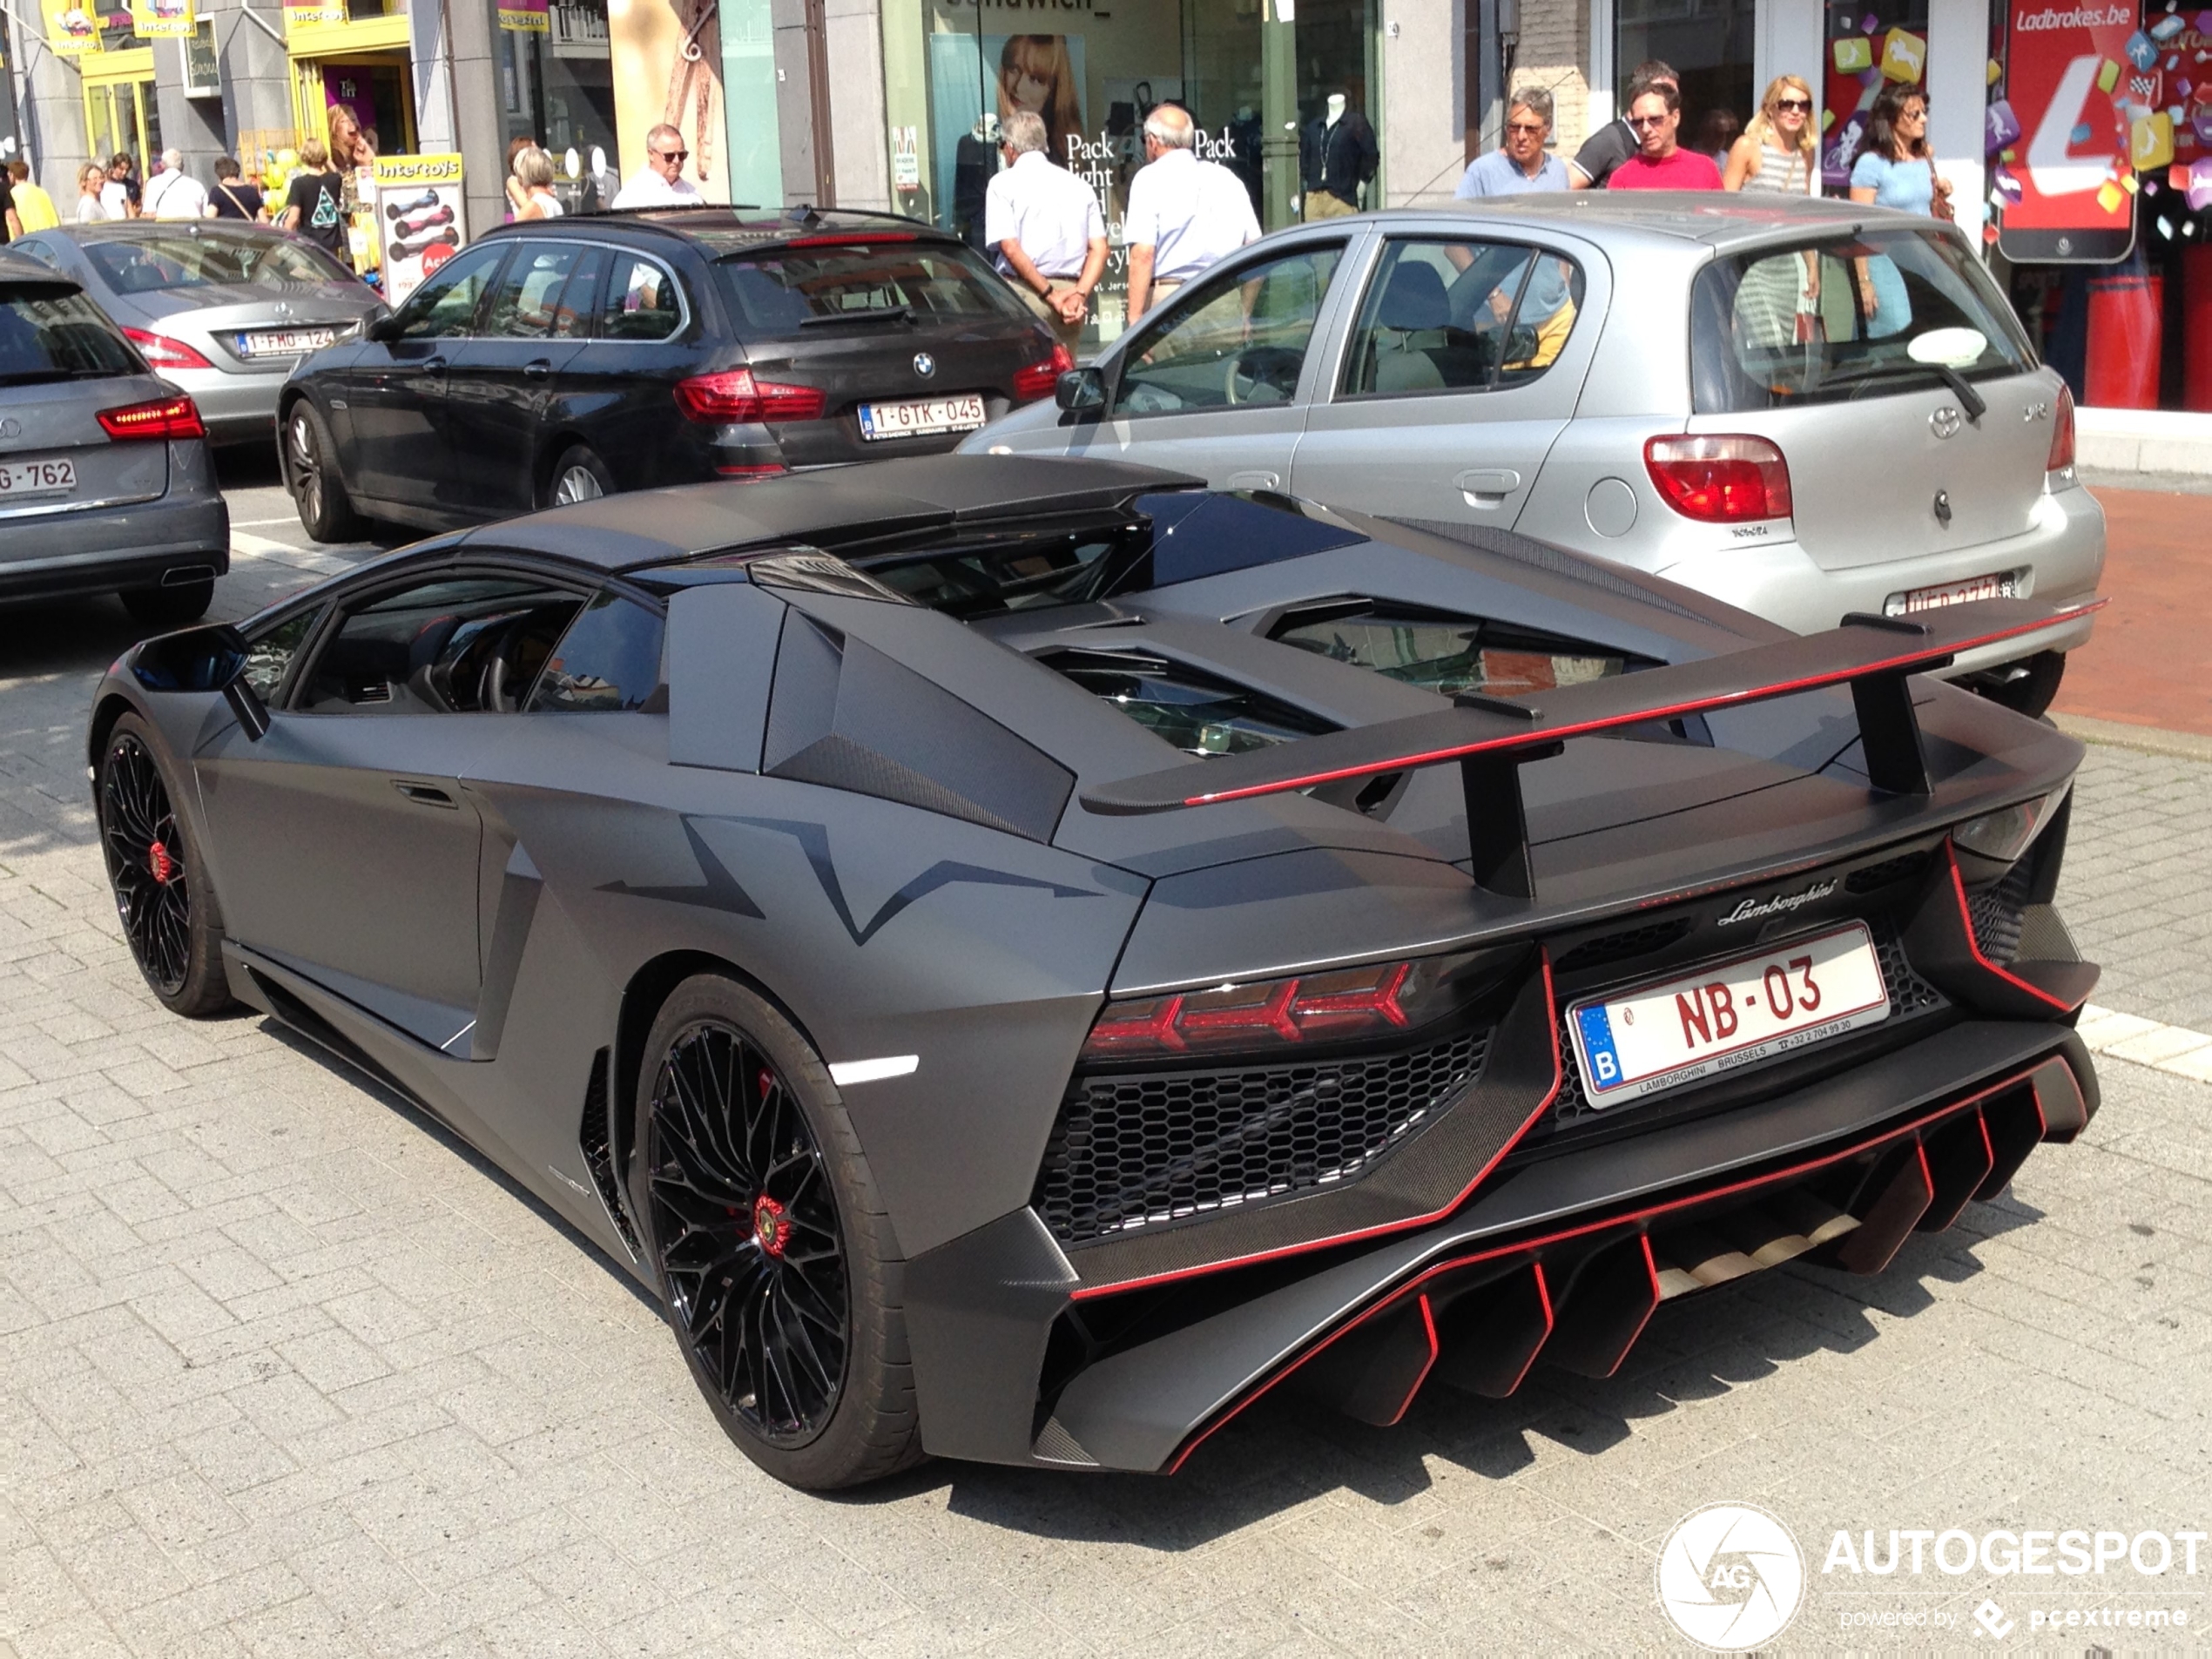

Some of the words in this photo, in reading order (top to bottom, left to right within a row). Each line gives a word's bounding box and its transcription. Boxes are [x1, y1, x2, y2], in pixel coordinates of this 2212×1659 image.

[2017, 4, 2130, 31] Ladbrokes.be
[1066, 131, 1115, 160] Pack
[1195, 125, 1237, 159] Pack
[377, 160, 459, 179] Intertoys
[1717, 879, 1838, 926] Lamborghini
[1675, 954, 1821, 1049] NB-03
[1595, 1051, 1617, 1081] B
[1639, 1065, 1707, 1093] LAMBORGHINI
[1717, 1046, 1767, 1069] BRUSSELS
[1806, 1031, 1812, 1042] 2
[1813, 1026, 1829, 1039] 704
[1829, 1023, 1840, 1035] 99
[1841, 1020, 1851, 1031] 30
